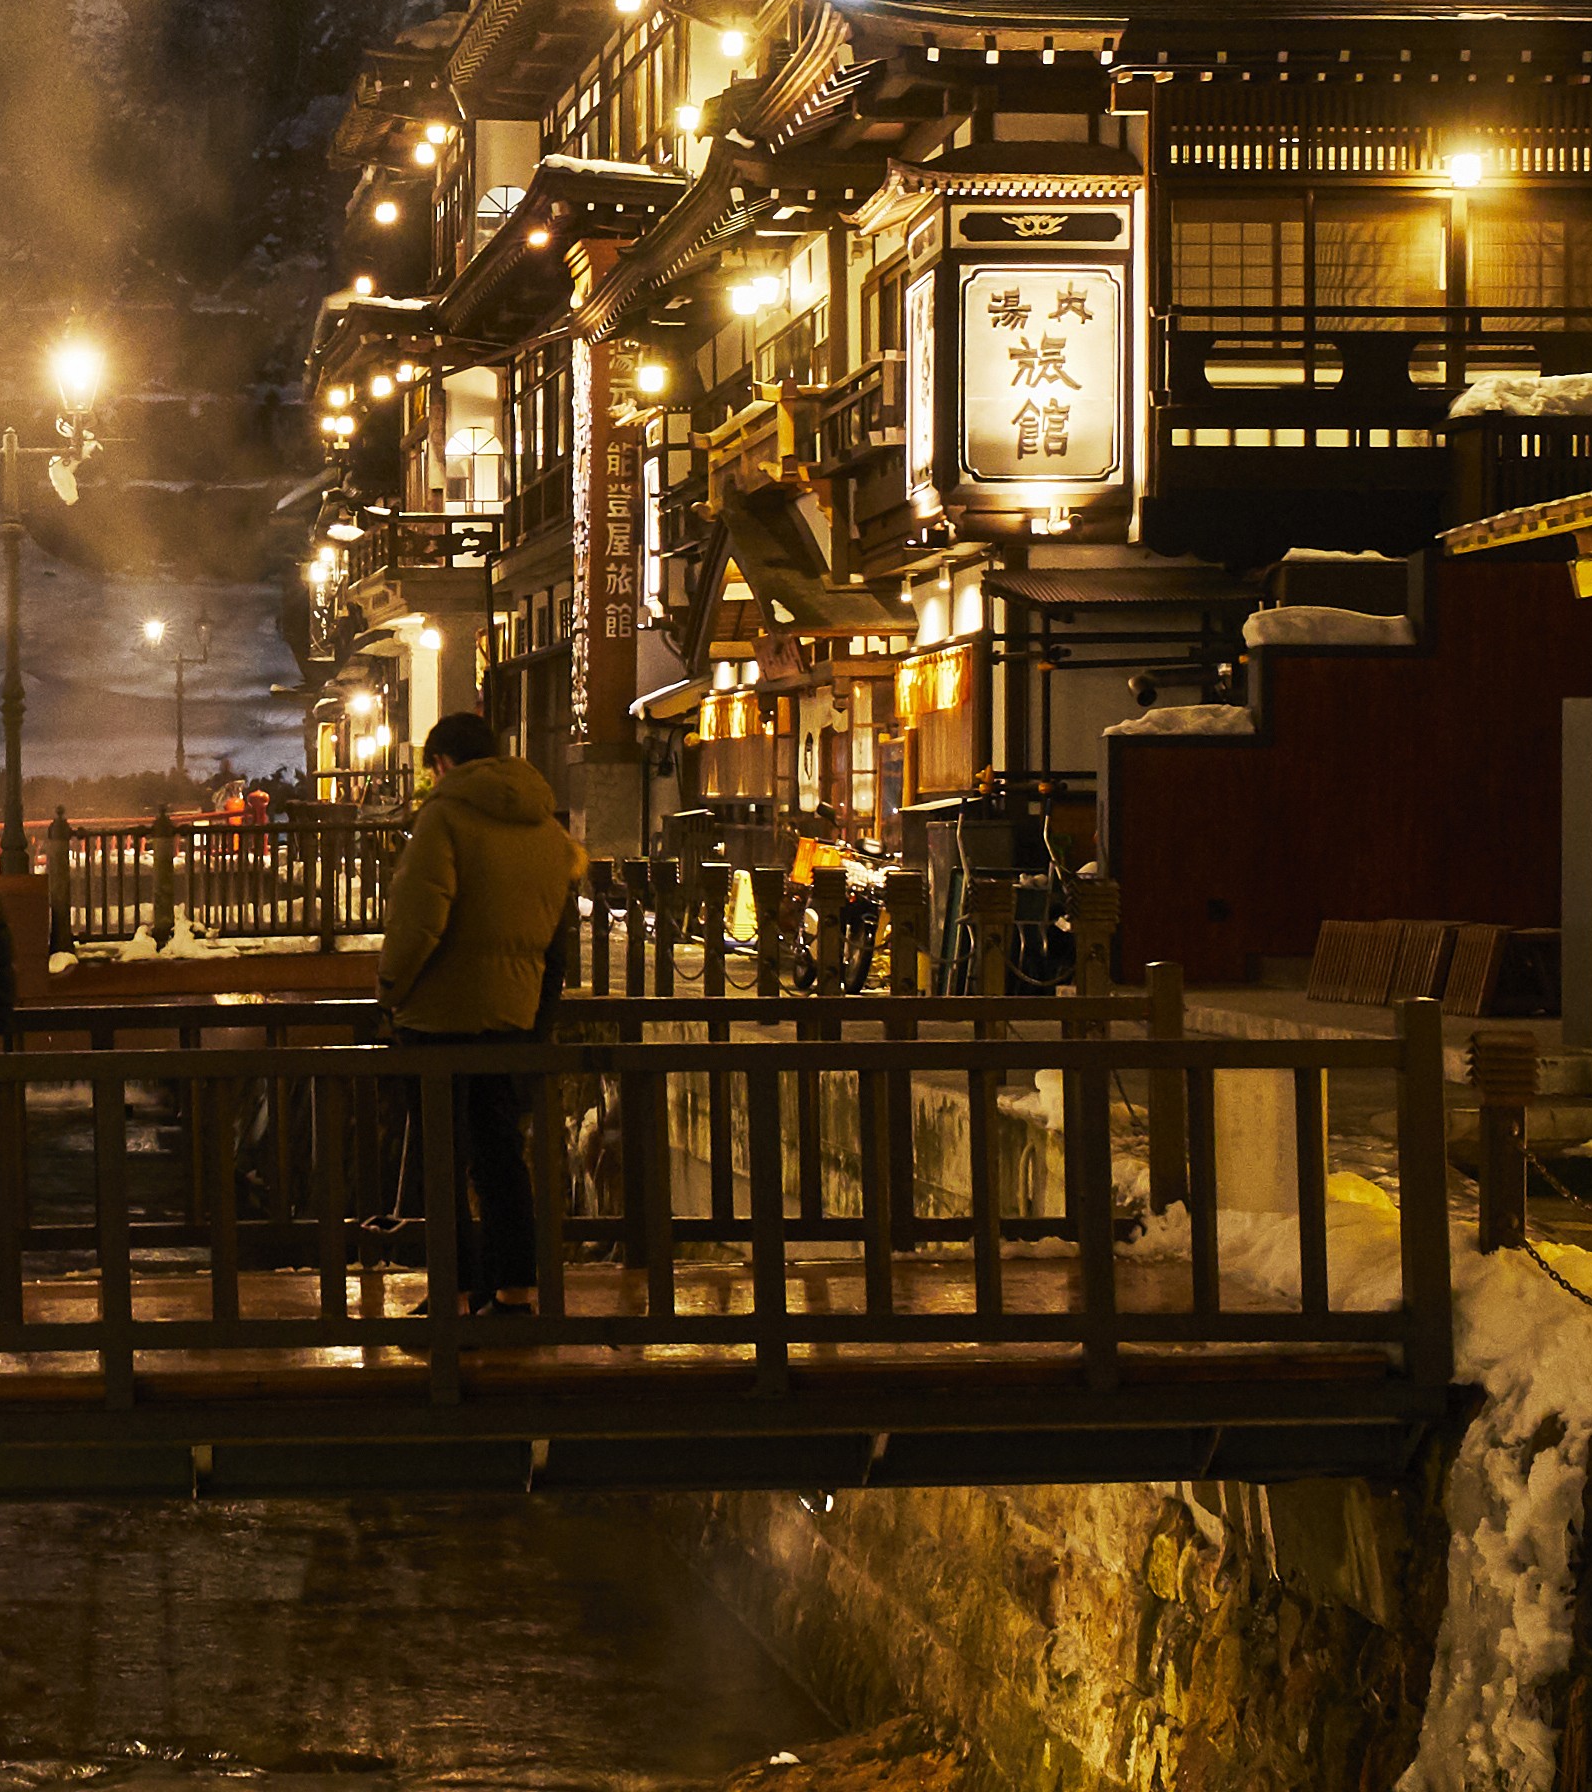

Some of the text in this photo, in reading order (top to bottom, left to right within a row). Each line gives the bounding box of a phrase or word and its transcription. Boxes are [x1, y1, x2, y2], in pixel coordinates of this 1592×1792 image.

[606, 441, 635, 638] 能登屋旅館
